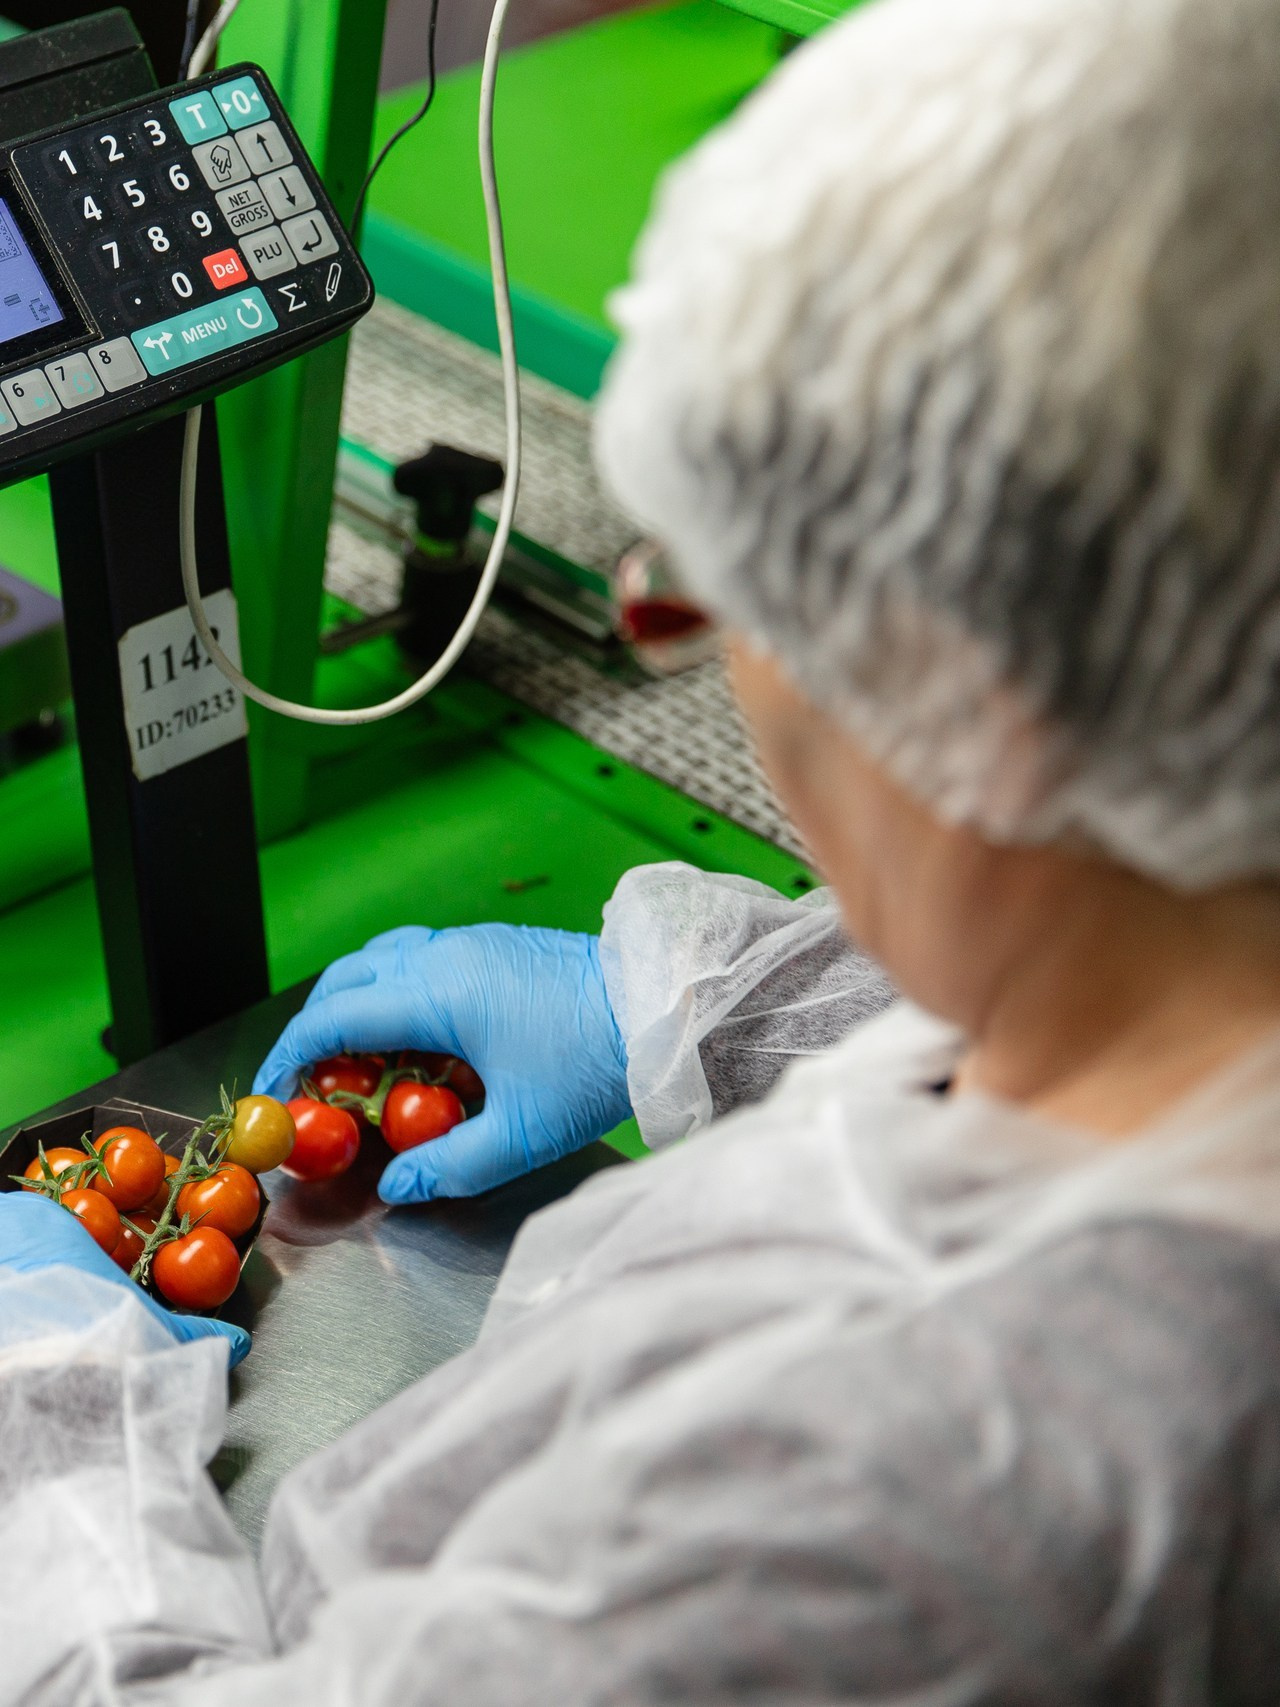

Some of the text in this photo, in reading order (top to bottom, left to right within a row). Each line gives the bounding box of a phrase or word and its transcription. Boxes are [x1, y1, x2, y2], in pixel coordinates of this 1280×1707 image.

[231, 89, 252, 115] 0
[186, 103, 207, 129] T
[58, 119, 167, 175] 1 2 3
[83, 164, 190, 221] 4 5 6
[228, 190, 252, 208] NET
[230, 205, 269, 228] GROSS
[102, 210, 213, 269] 7 8 9
[253, 242, 283, 263] PLU
[212, 258, 239, 279] Del
[171, 271, 193, 298] 0
[181, 316, 228, 345] MENU
[12, 382, 25, 398] 6
[54, 366, 66, 382] 7
[98, 350, 112, 365] 8
[136, 688, 235, 750] ID:70233
